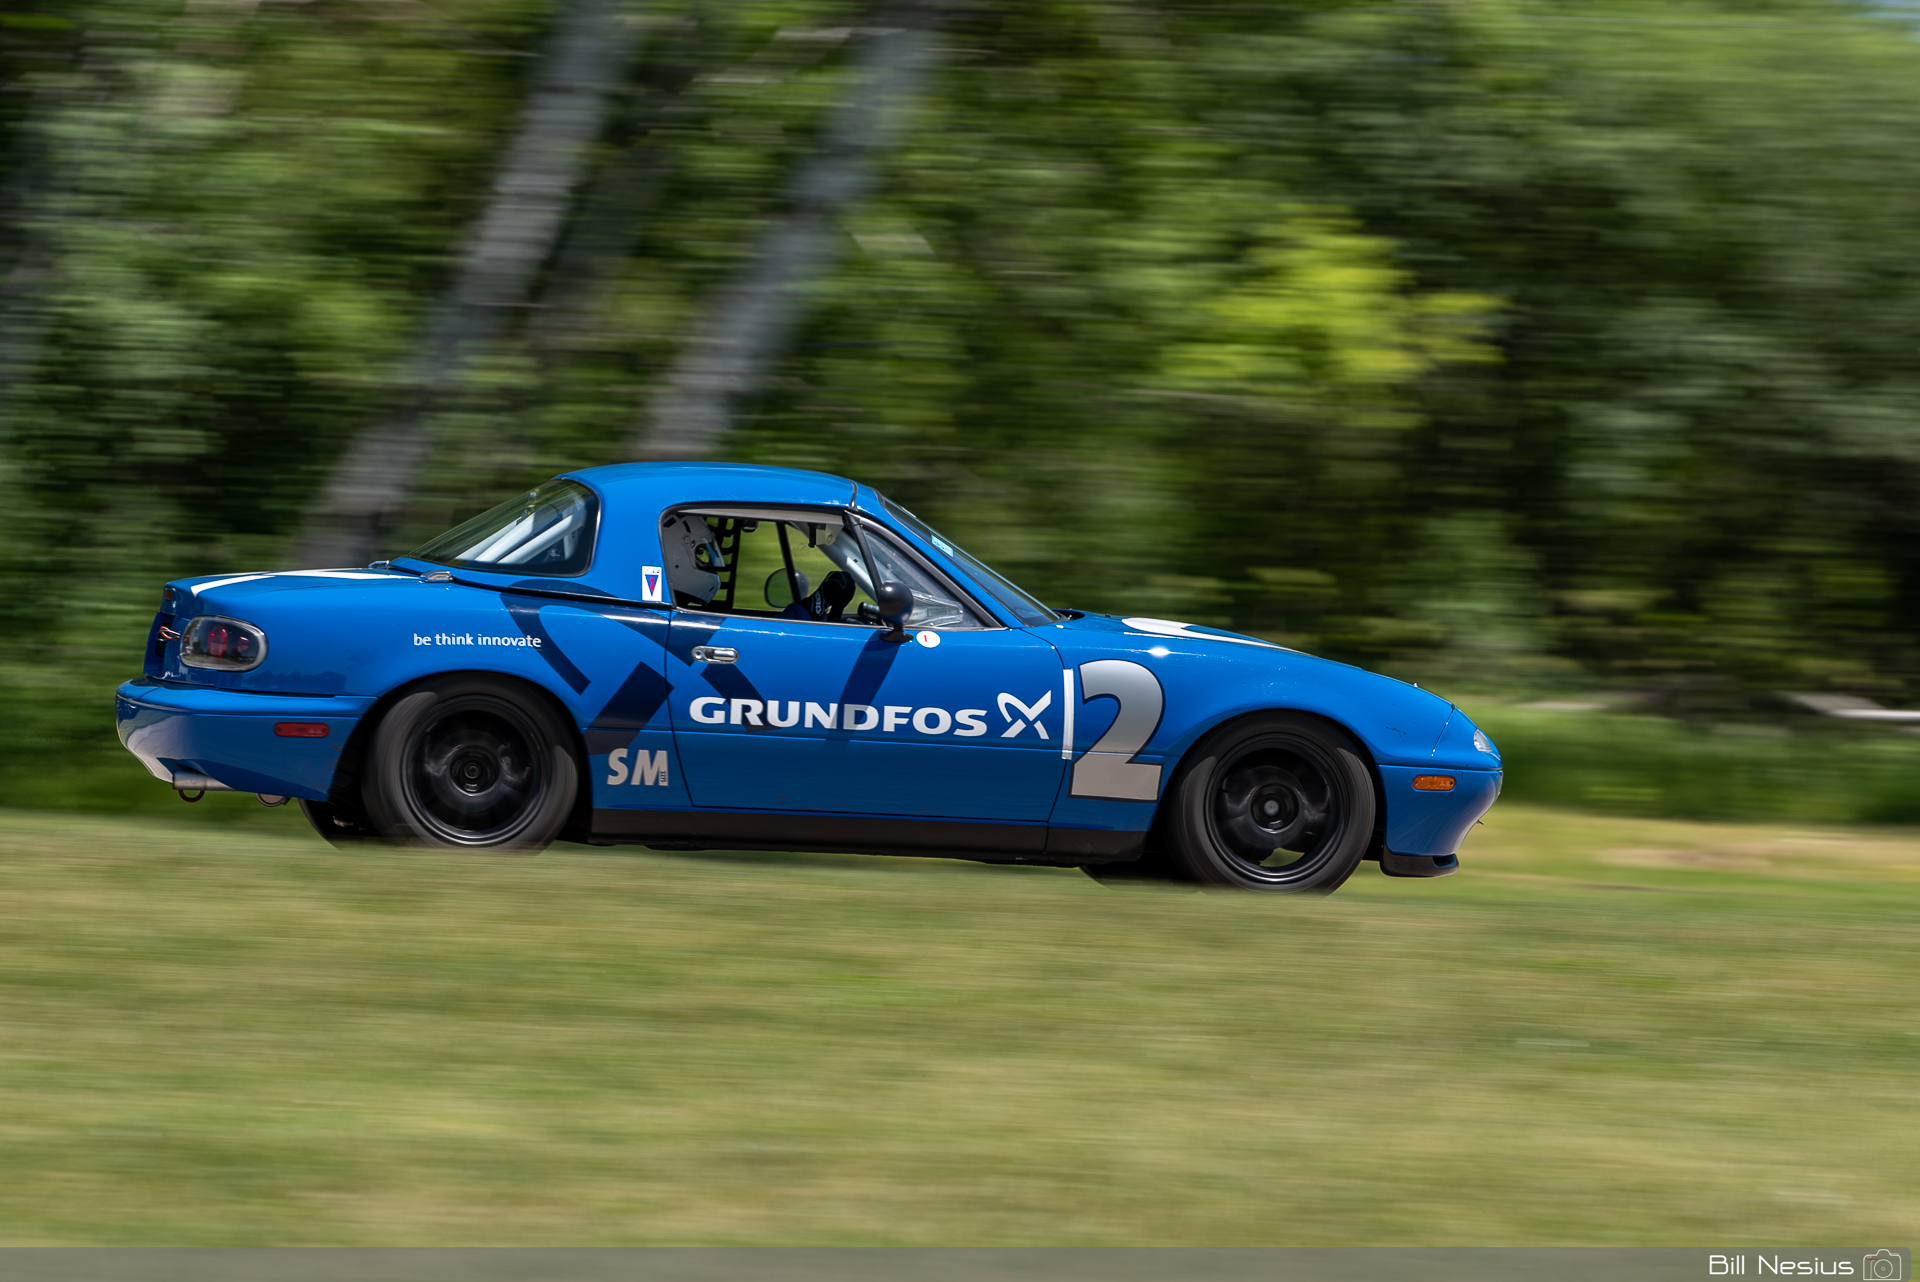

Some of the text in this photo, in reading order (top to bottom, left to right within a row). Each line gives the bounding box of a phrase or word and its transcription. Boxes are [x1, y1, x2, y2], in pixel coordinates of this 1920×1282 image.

[413, 633, 542, 647] be think innovate
[689, 696, 988, 737] GRUNDFOS
[607, 748, 669, 787] SM
